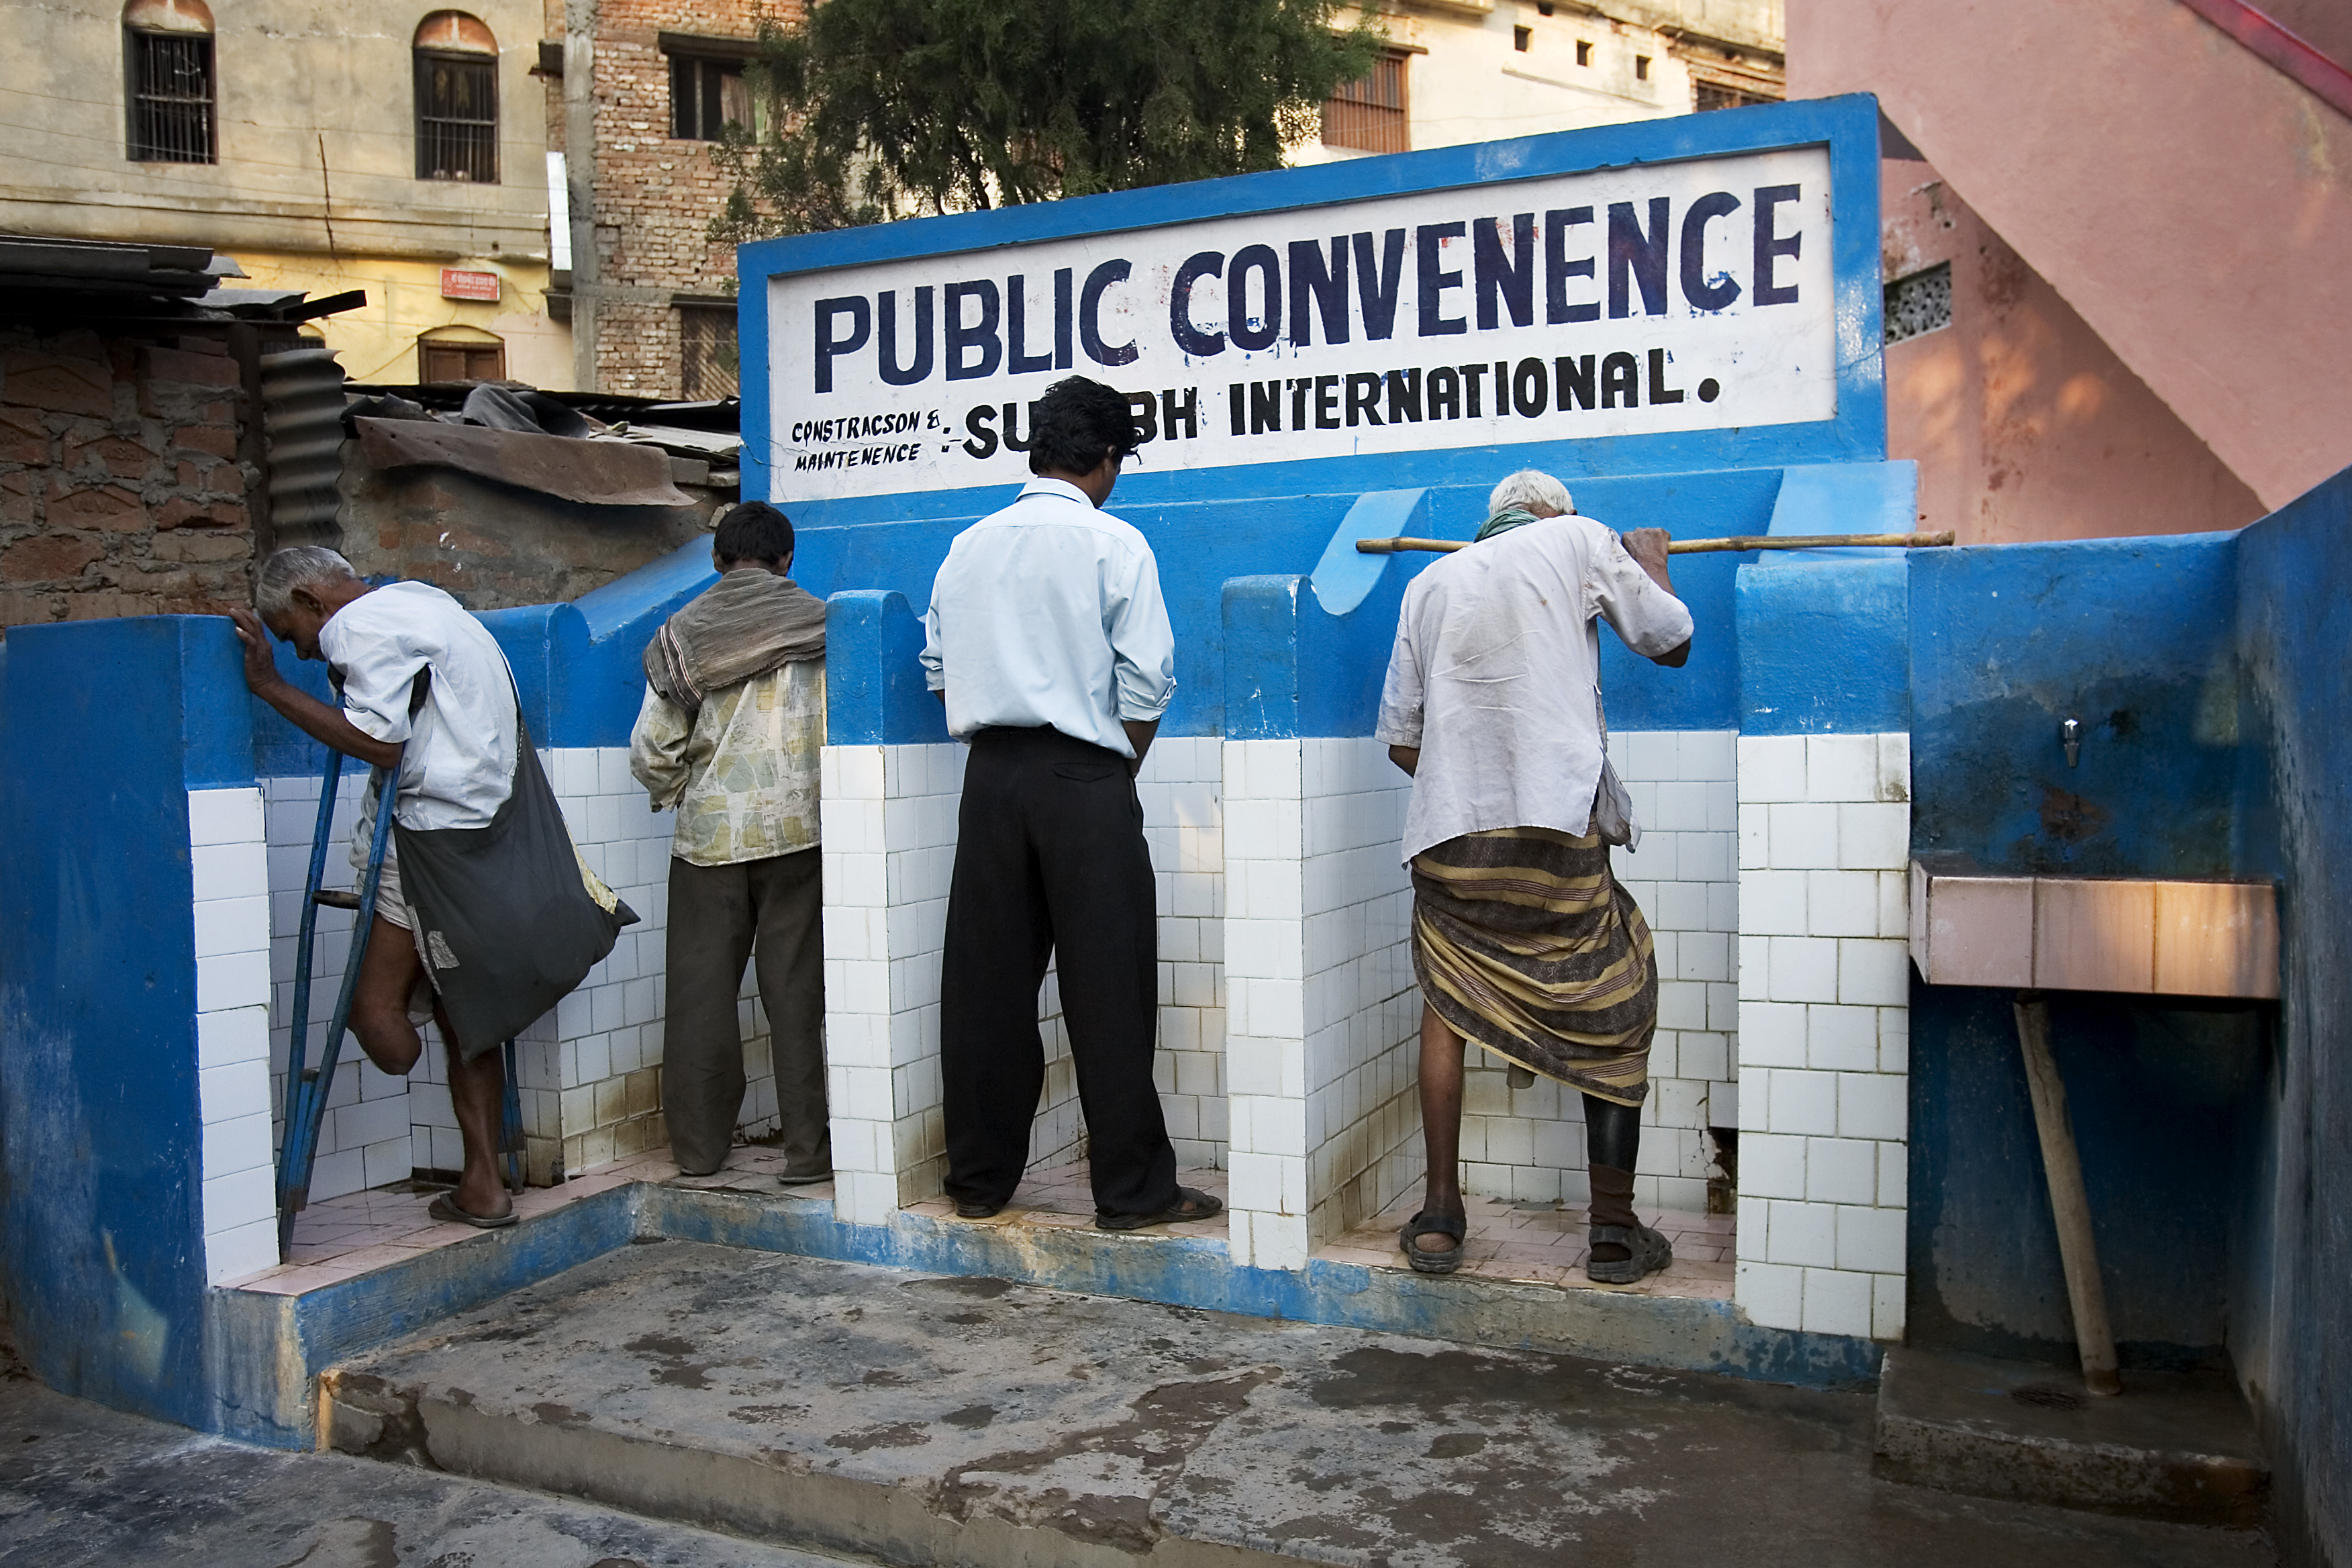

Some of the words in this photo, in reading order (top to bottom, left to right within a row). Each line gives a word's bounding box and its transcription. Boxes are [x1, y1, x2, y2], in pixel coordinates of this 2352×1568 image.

[814, 258, 1140, 394] PUBLIC
[1171, 183, 1802, 358] CONVENENCE
[791, 411, 920, 446] CONSTRACSON
[927, 409, 940, 430] &
[963, 386, 1197, 459] SUBH
[1229, 348, 1720, 436] INTERNATIONAL.
[795, 443, 922, 473] MAINTENENCE
